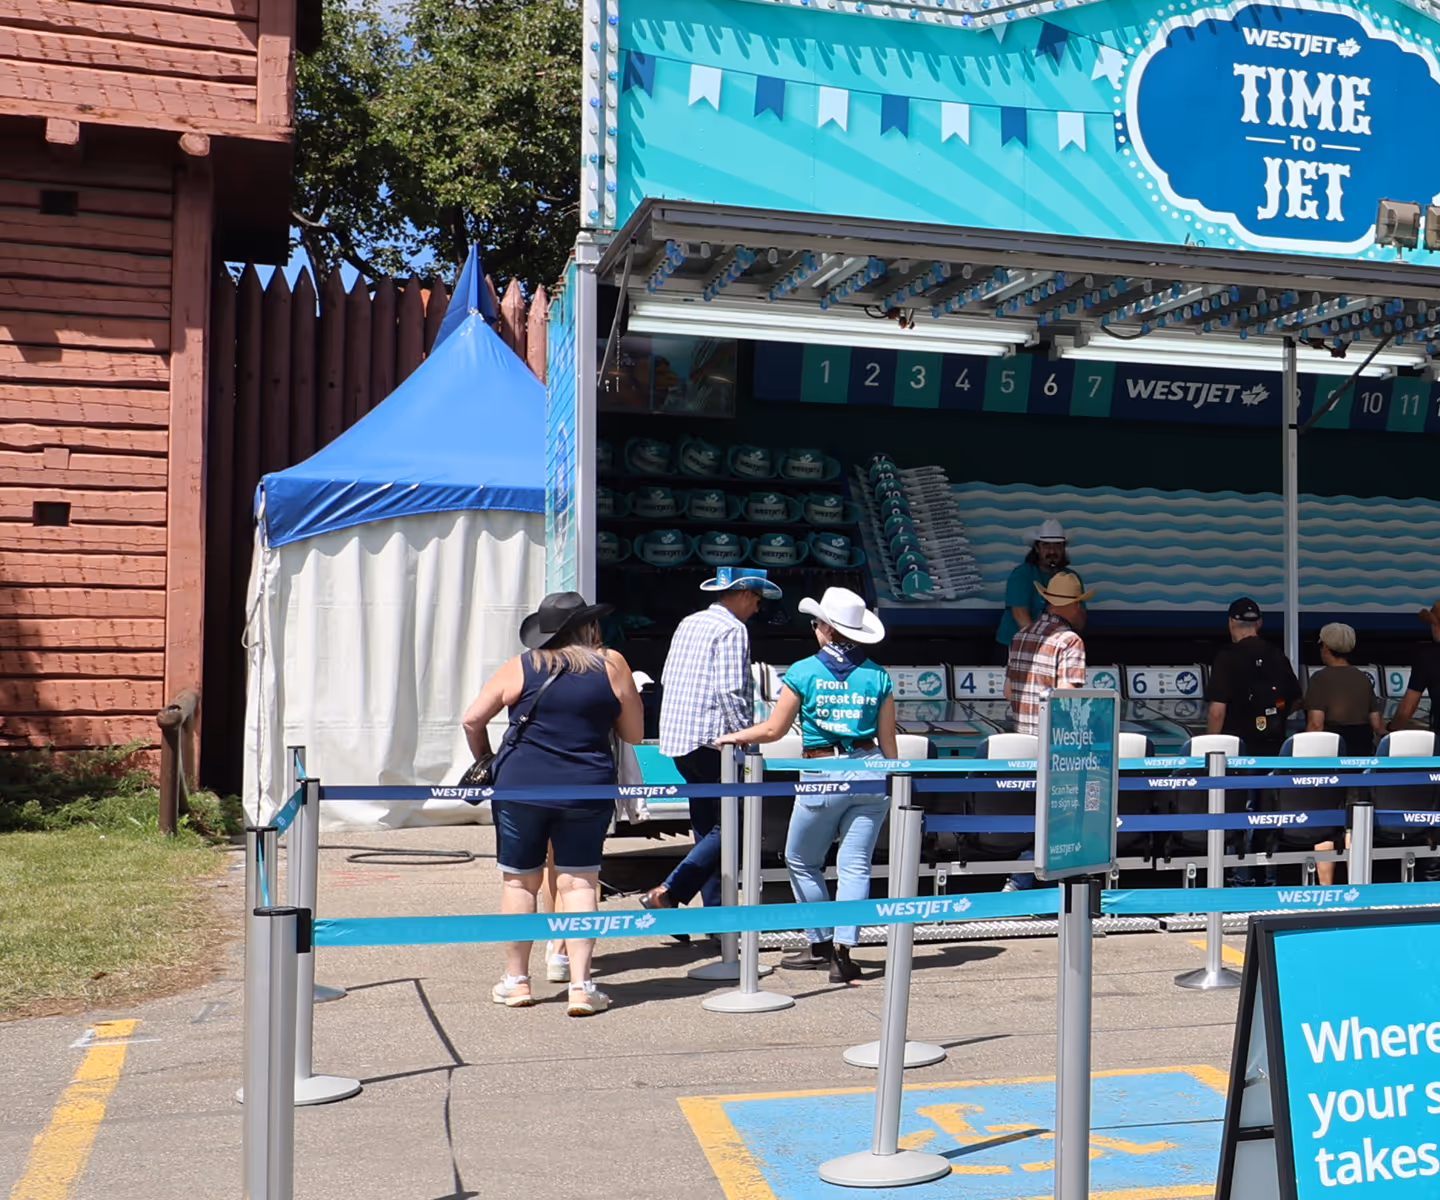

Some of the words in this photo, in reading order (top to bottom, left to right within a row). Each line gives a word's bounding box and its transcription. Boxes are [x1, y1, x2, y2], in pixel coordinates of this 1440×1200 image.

[1242, 27, 1337, 57] WESTJET
[1233, 62, 1372, 135] TIME
[1290, 135, 1316, 152] TO
[1257, 157, 1350, 221] JET
[820, 360, 831, 384] 1
[865, 363, 881, 387] 2
[910, 365, 926, 389] 3
[955, 368, 971, 392] 4
[1000, 371, 1015, 393] 5
[1043, 373, 1058, 396] 6
[1088, 376, 1102, 398] 7
[1126, 379, 1240, 408] WESTJET
[1361, 391, 1382, 414] 10
[1401, 394, 1419, 416] 11
[816, 678, 849, 690] From
[960, 672, 977, 694] 4
[1133, 672, 1147, 694] 6
[1390, 672, 1404, 693] 9
[816, 693, 850, 707] great
[816, 707, 829, 717] to
[1052, 728, 1093, 749] WestJet
[864, 760, 901, 770] WESTJET
[1052, 754, 1100, 772] Rewards.
[1144, 758, 1178, 768] WESTJET
[794, 783, 839, 794] WESTJET
[1051, 786, 1066, 796] Scan
[1066, 784, 1079, 795] here
[1148, 778, 1188, 789] WESTJET
[1292, 776, 1330, 787] WESTJET
[431, 787, 482, 799] WESTJET
[618, 786, 666, 797] WESTJET
[1051, 799, 1058, 808] to
[1058, 798, 1072, 810] sign
[1248, 814, 1296, 828] WESTJET
[1277, 889, 1344, 906] WESTJET
[875, 900, 953, 919] WESTJET
[547, 915, 634, 935] WESTJET
[1307, 1083, 1415, 1139] your
[1314, 1137, 1440, 1187] takes
